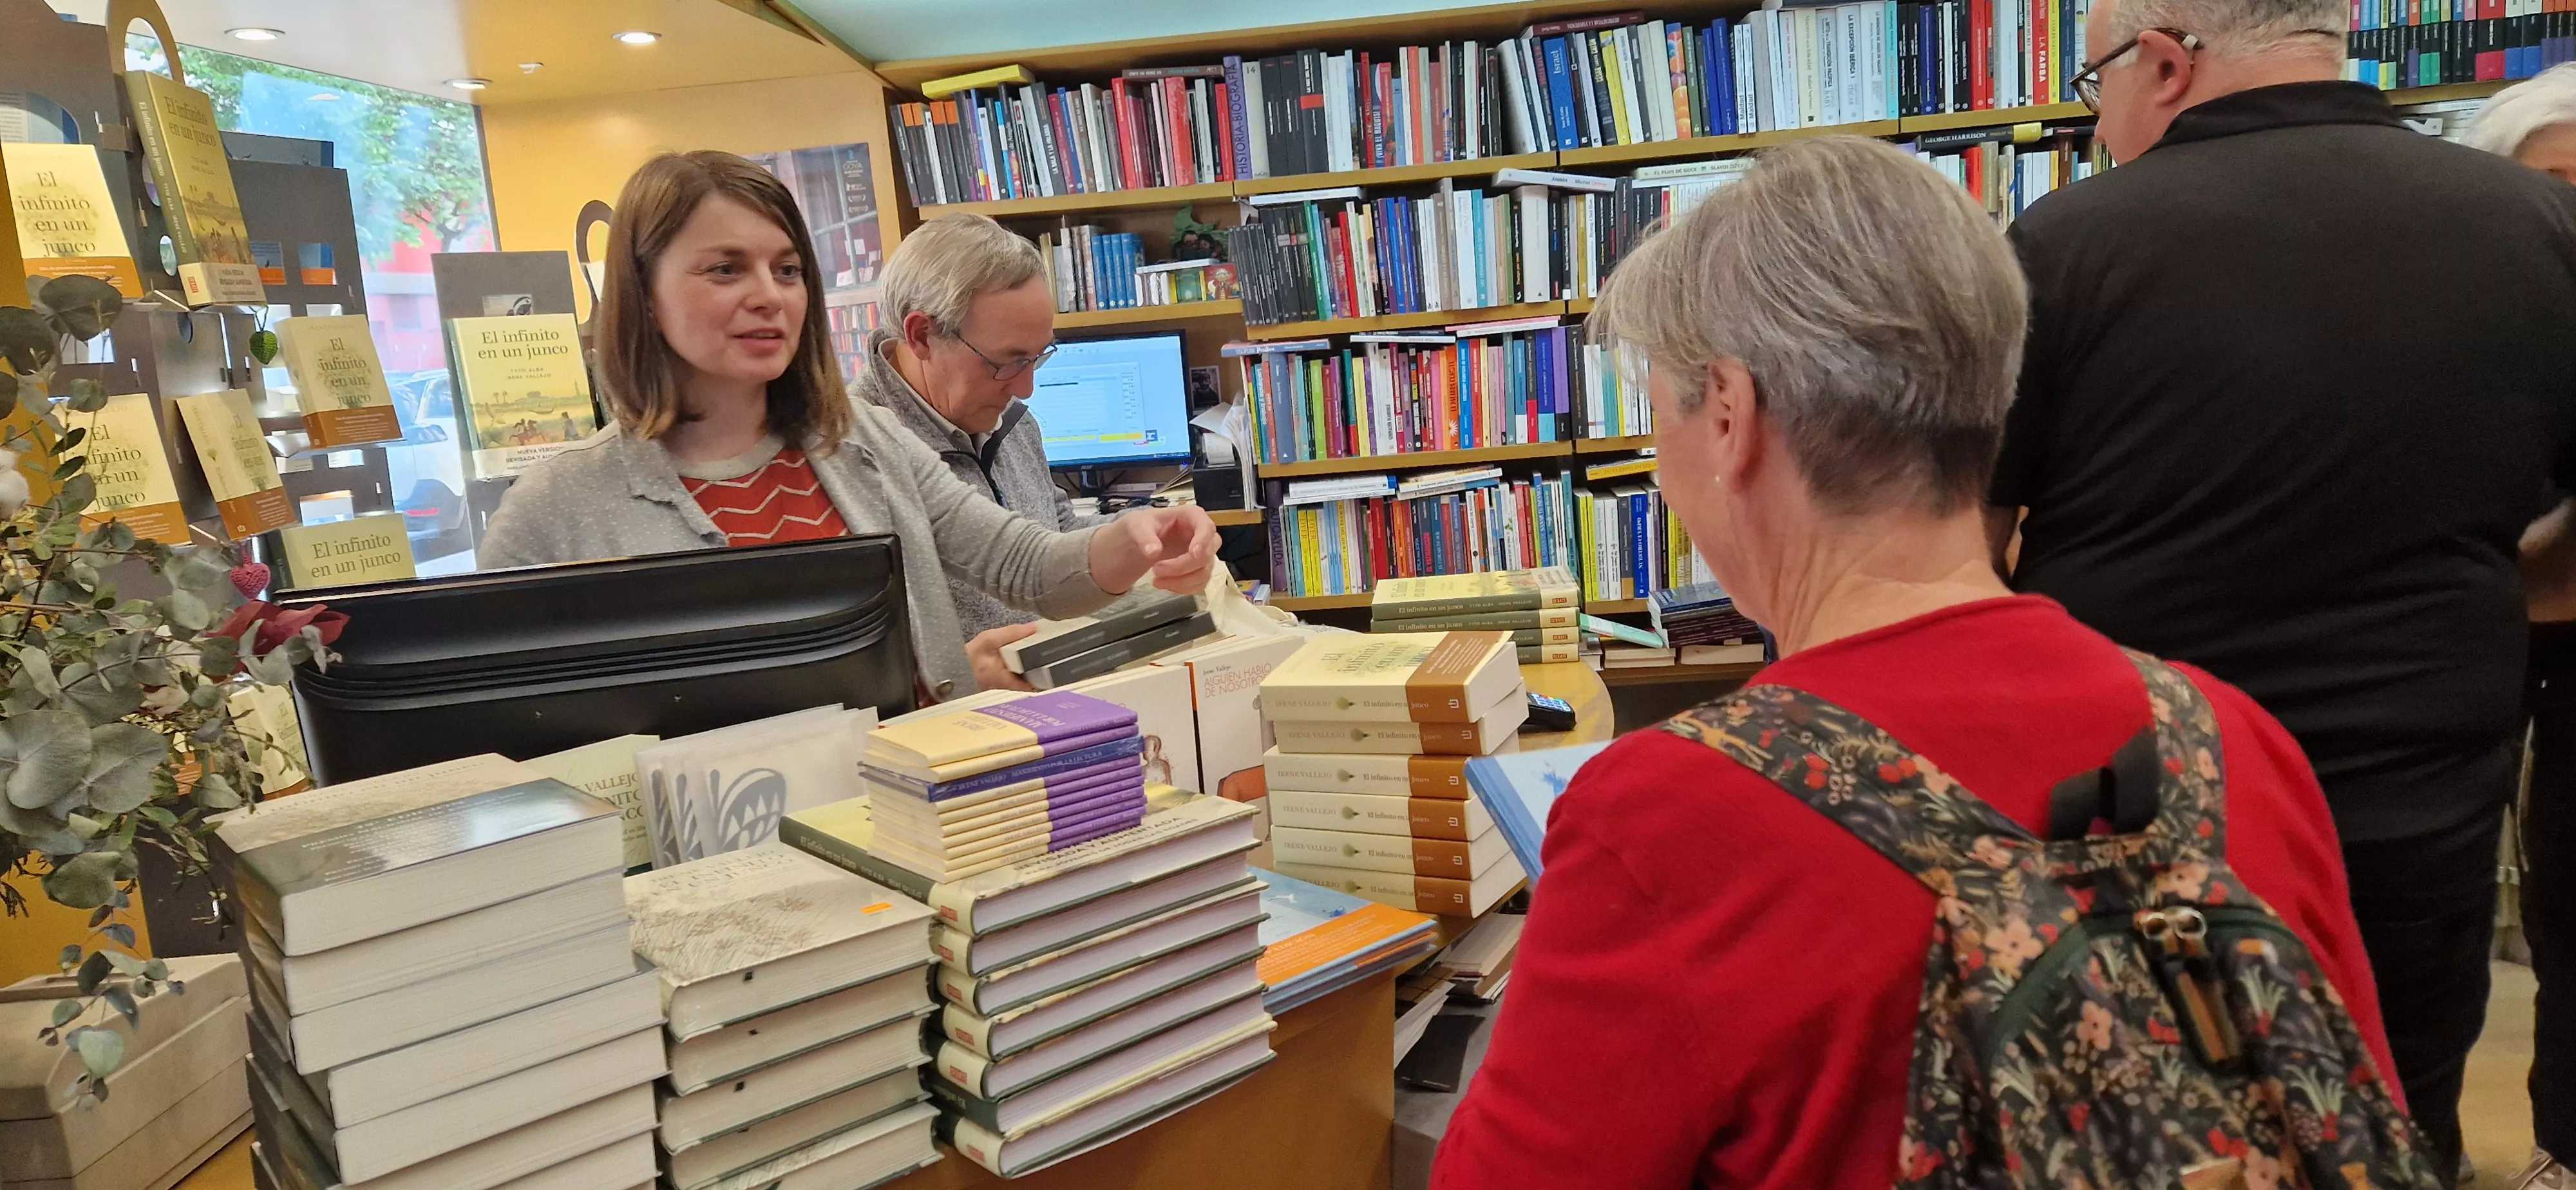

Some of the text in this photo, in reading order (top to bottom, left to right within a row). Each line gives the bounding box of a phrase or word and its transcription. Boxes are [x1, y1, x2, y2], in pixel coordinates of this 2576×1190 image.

[1588, 39, 1598, 54] CATÓN
[1551, 50, 1562, 75] Israel
[2038, 37, 2047, 82] LA FARSA
[1246, 66, 1256, 75] 14
[1594, 67, 1604, 82] CÉSAR
[138, 101, 146, 110] El
[164, 96, 207, 126] El infinito
[1738, 95, 1746, 120] Maldad
[1747, 94, 1755, 119] Maldad
[140, 109, 154, 138] infinito
[1226, 62, 1248, 175] HISTORIA-BIOGRAFÍA
[1372, 111, 1382, 134] MAQUIS!
[169, 121, 216, 147] en un junco
[1043, 124, 1053, 144] PALABRA
[1953, 132, 1987, 142] HARRISON
[1375, 143, 1384, 159] ¡VIVA
[153, 154, 165, 177] junco
[843, 162, 863, 170] GOYA
[1050, 155, 1058, 167] BALA
[36, 171, 57, 187] El
[18, 194, 90, 211] infinito
[35, 219, 90, 232] en un
[42, 239, 96, 258] junco
[482, 328, 560, 344] El infinito
[330, 337, 345, 352] El
[478, 344, 569, 361] en un junco
[319, 356, 366, 372] infinito
[331, 375, 366, 388] en un
[336, 393, 371, 409] junco
[232, 413, 243, 429] El
[88, 424, 111, 442] El
[231, 437, 260, 451] infinito
[95, 491, 146, 512] junco
[1271, 506, 1283, 567] AUTOAYUDA
[312, 534, 391, 560] El infinito
[311, 552, 401, 578] en un junco
[1406, 605, 1428, 614] infinito
[1446, 603, 1464, 612] junco
[1405, 622, 1428, 630] infinito
[1445, 621, 1463, 630] junco
[1321, 653, 1344, 661] El
[1337, 642, 1385, 672] infinito
[1376, 646, 1410, 669] en un
[1204, 661, 1273, 688] ALGUIEN HABLÓ
[1216, 665, 1231, 673] Vallejo
[1205, 687, 1217, 698] DE
[1423, 733, 1442, 741] junco
[1305, 807, 1337, 815] VALLEJO
[1412, 815, 1430, 824] junco
[1100, 816, 1182, 845] AUMENTADA
[800, 835, 807, 847] El
[807, 839, 826, 856] infinito
[840, 854, 857, 871] junco
[1283, 842, 1338, 853] IRENE VALLEJO
